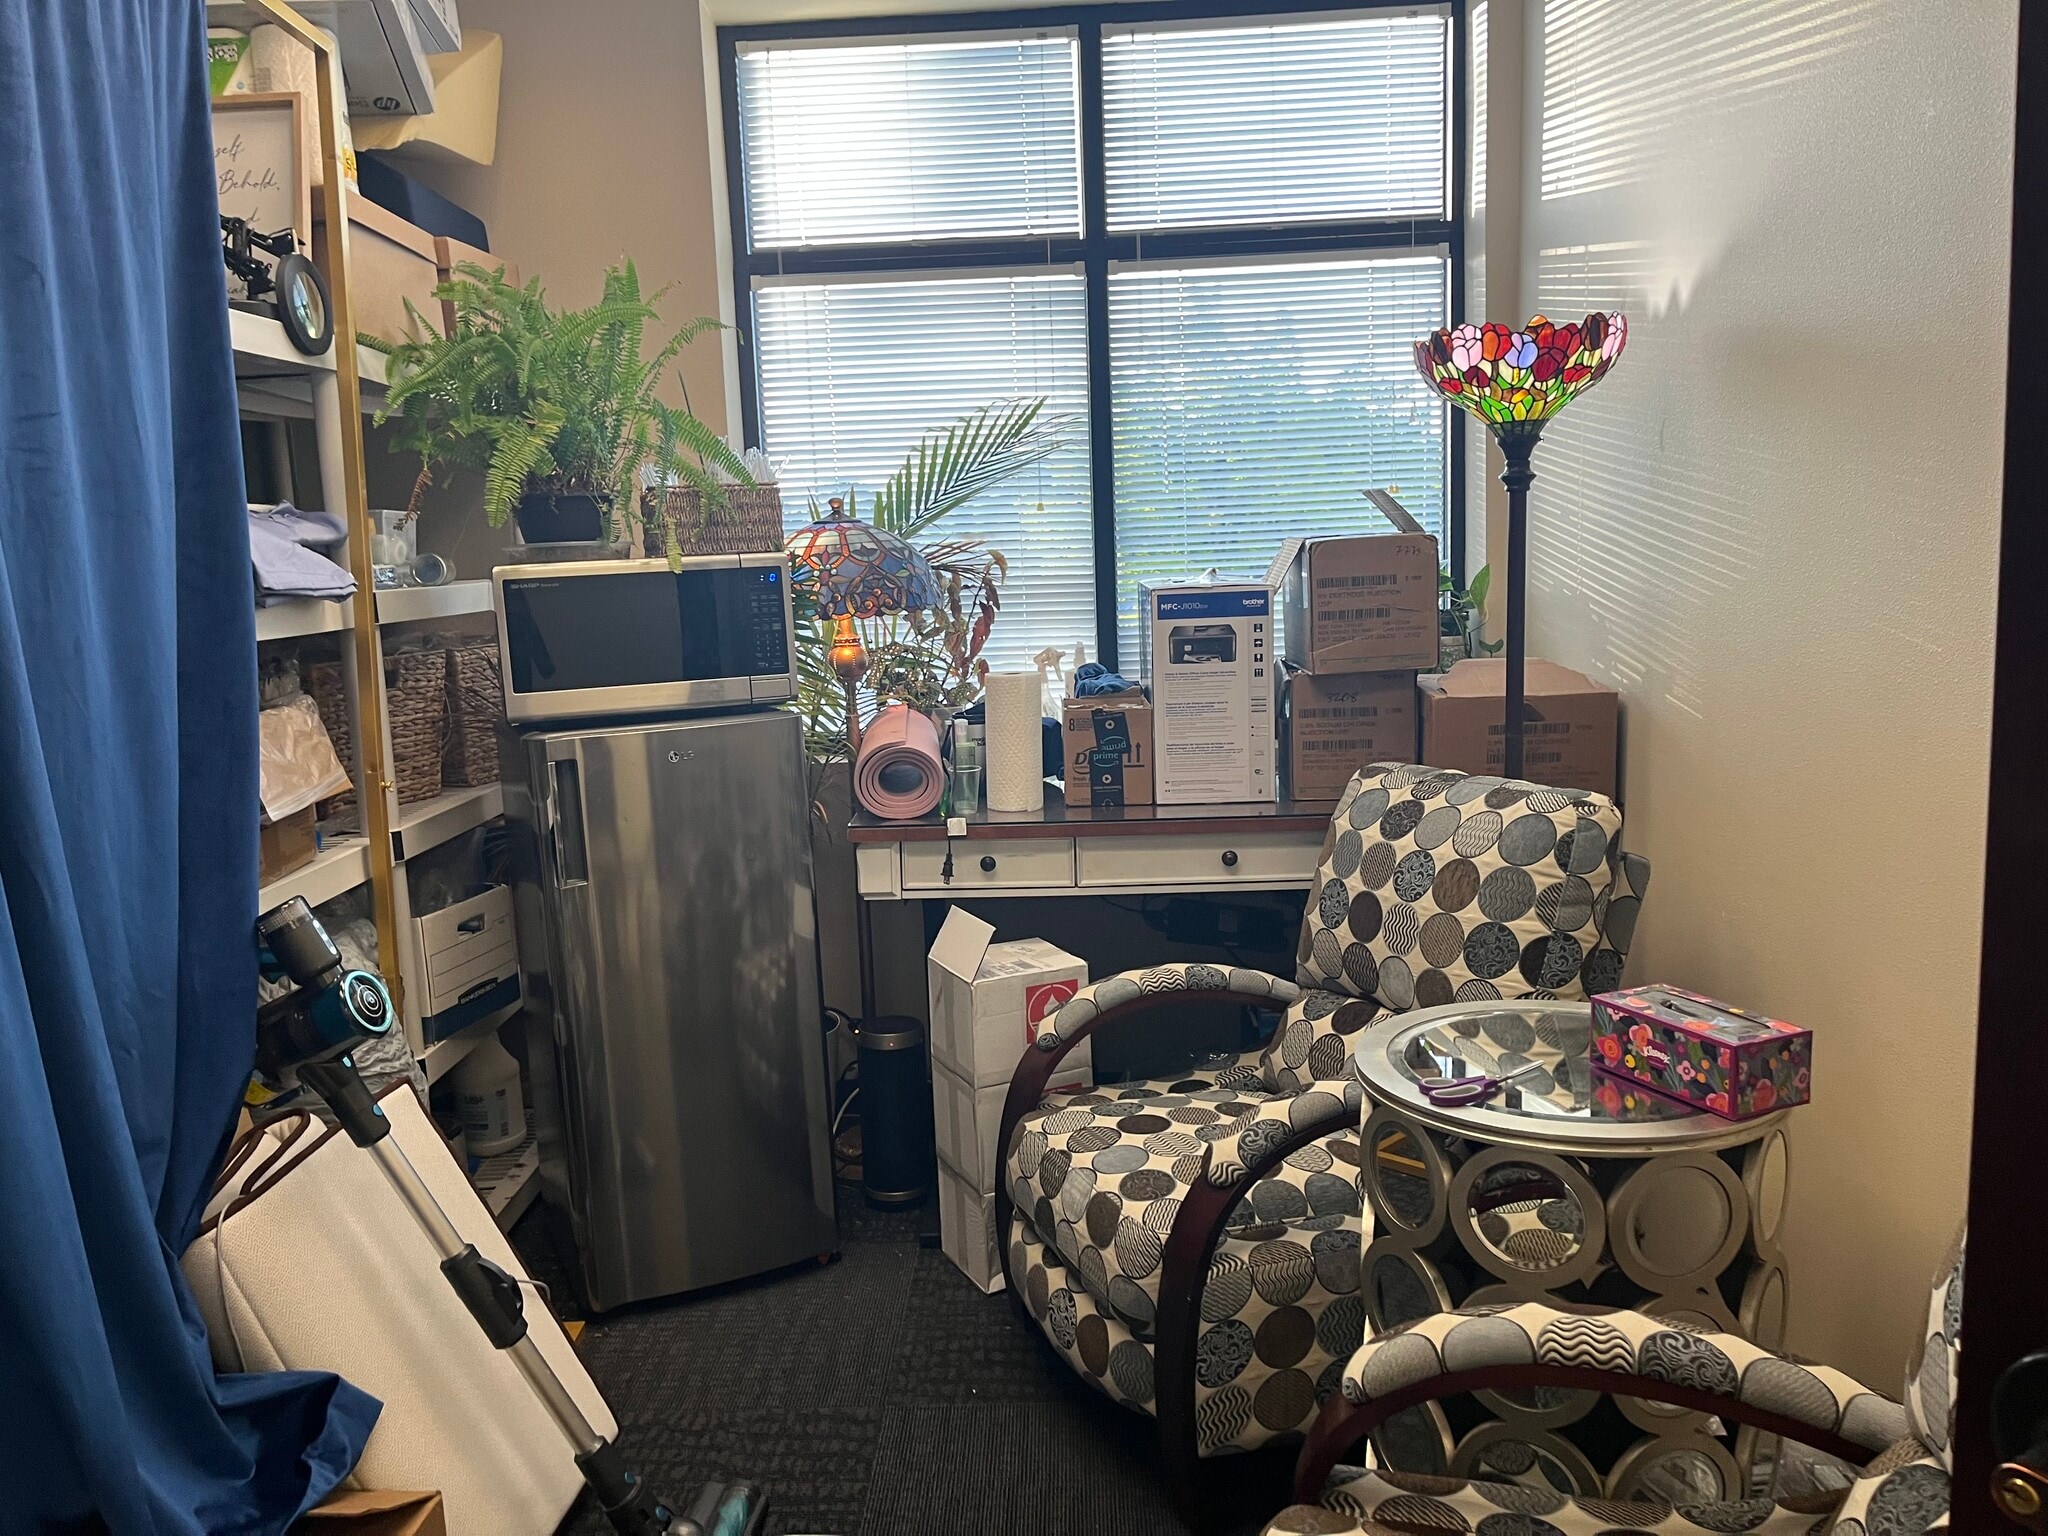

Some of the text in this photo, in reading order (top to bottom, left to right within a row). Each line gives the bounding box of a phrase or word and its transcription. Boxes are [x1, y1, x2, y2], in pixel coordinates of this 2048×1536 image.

[218, 168, 280, 194] Behold,
[1242, 598, 1265, 606] brother
[1069, 718, 1075, 731] 8
[1093, 752, 1119, 761] prime
[1642, 1045, 1670, 1063] Kleenex
